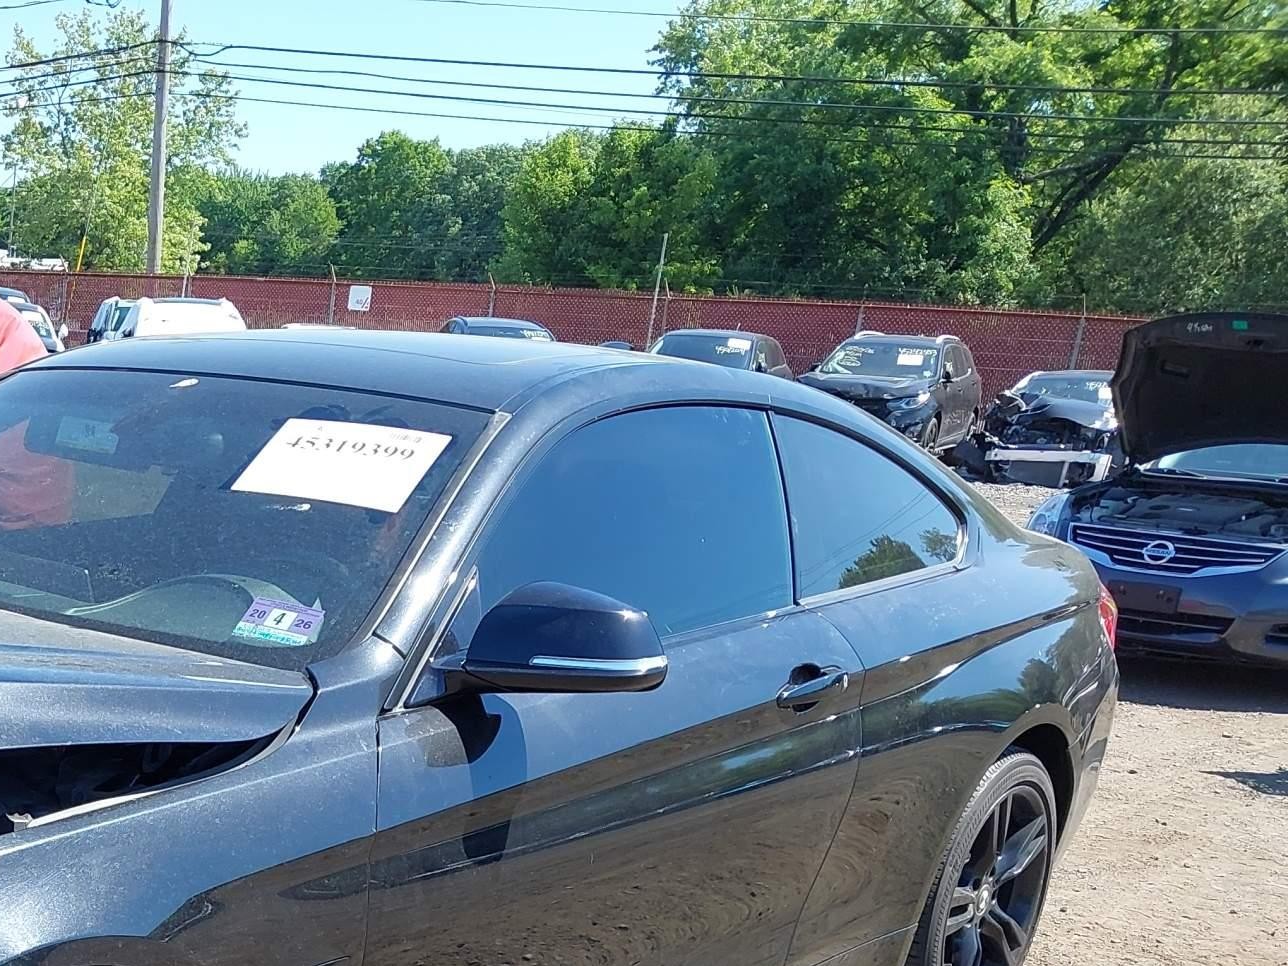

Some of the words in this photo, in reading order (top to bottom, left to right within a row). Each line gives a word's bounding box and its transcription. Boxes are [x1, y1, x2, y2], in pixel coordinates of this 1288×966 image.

[286, 436, 415, 460] 45319399
[249, 608, 267, 619] 20
[273, 612, 287, 626] 4
[294, 618, 313, 630] 26
